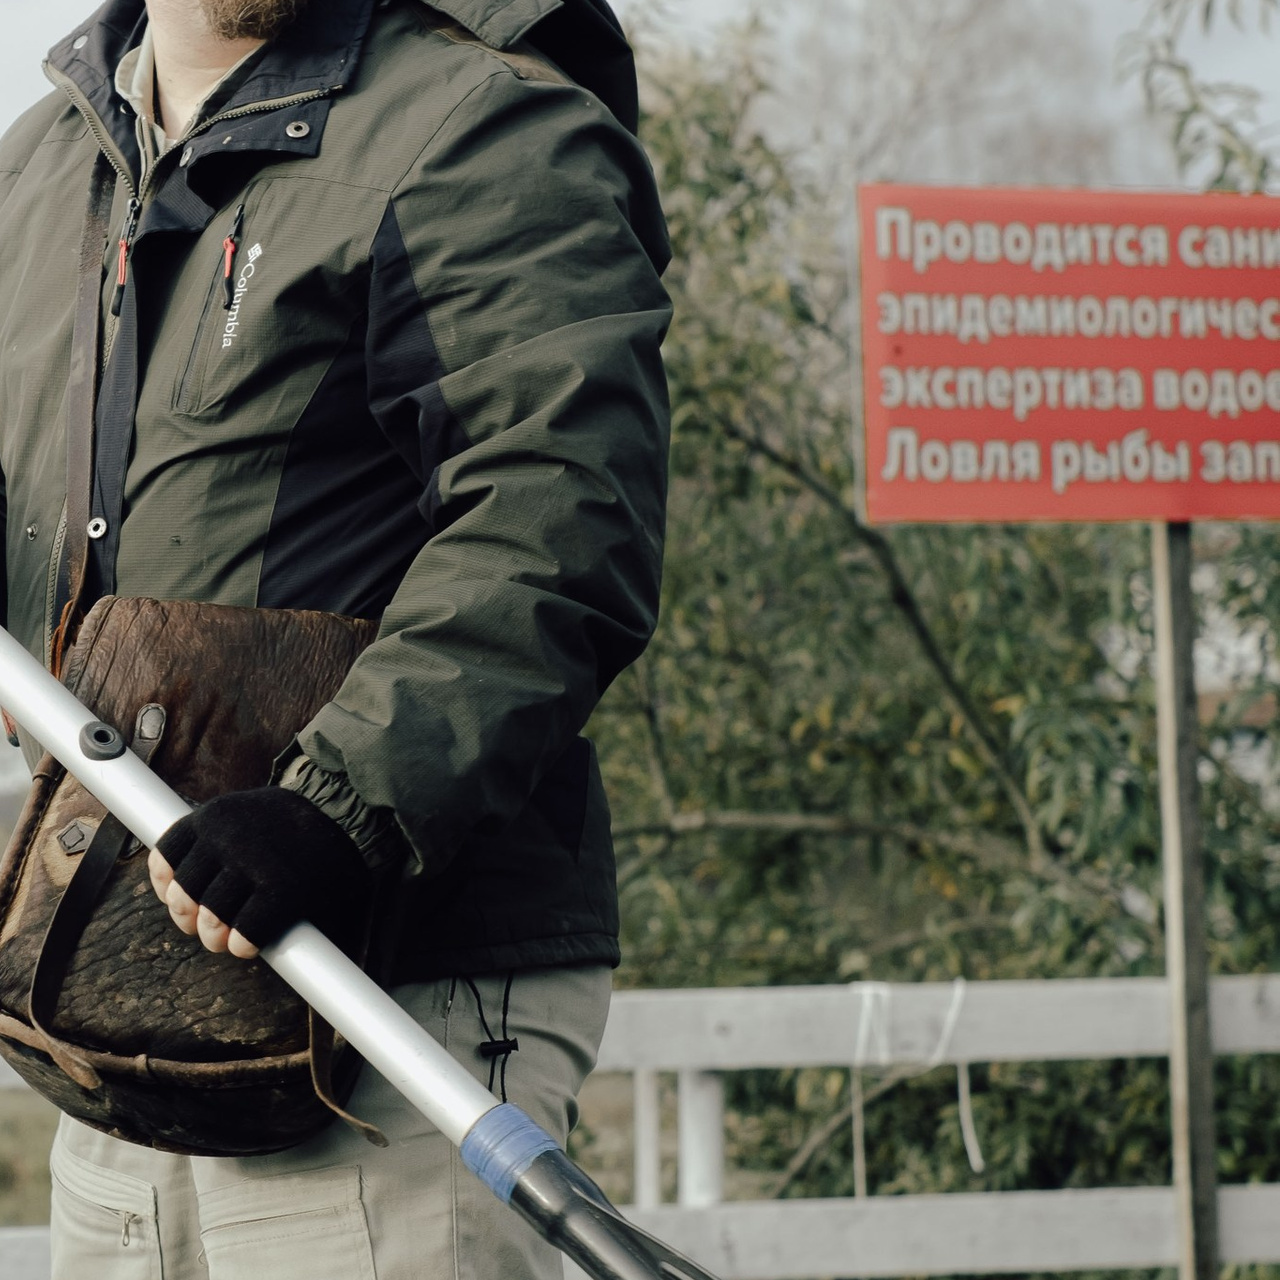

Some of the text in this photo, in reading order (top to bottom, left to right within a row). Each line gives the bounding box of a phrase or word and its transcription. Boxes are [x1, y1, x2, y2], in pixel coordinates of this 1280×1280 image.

[875, 206, 1169, 274] Проводится
[221, 263, 255, 349] Columbia
[877, 292, 1280, 345] эпидемиологичес
[879, 366, 1144, 422] экспертиза
[881, 426, 1280, 495] Ловля рыбы зап
